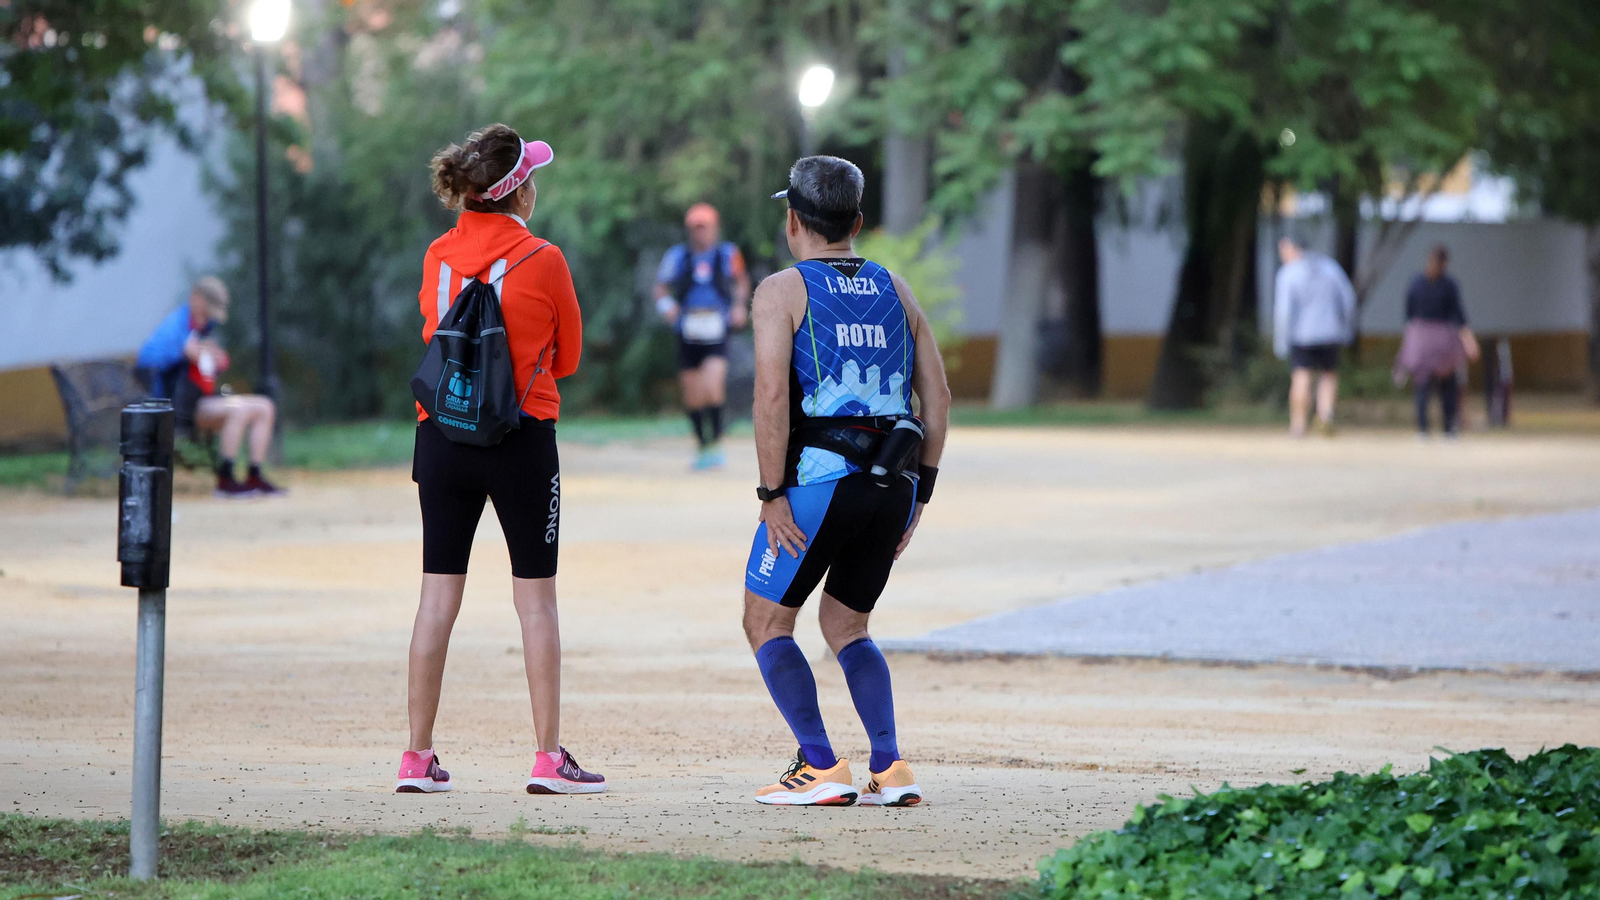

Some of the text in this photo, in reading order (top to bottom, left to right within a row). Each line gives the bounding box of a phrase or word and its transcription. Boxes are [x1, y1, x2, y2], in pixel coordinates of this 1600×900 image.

[825, 276, 880, 295] I. BAEZA
[835, 323, 887, 349] ROTA
[438, 415, 477, 431] CONTIGO
[545, 472, 559, 544] WONG
